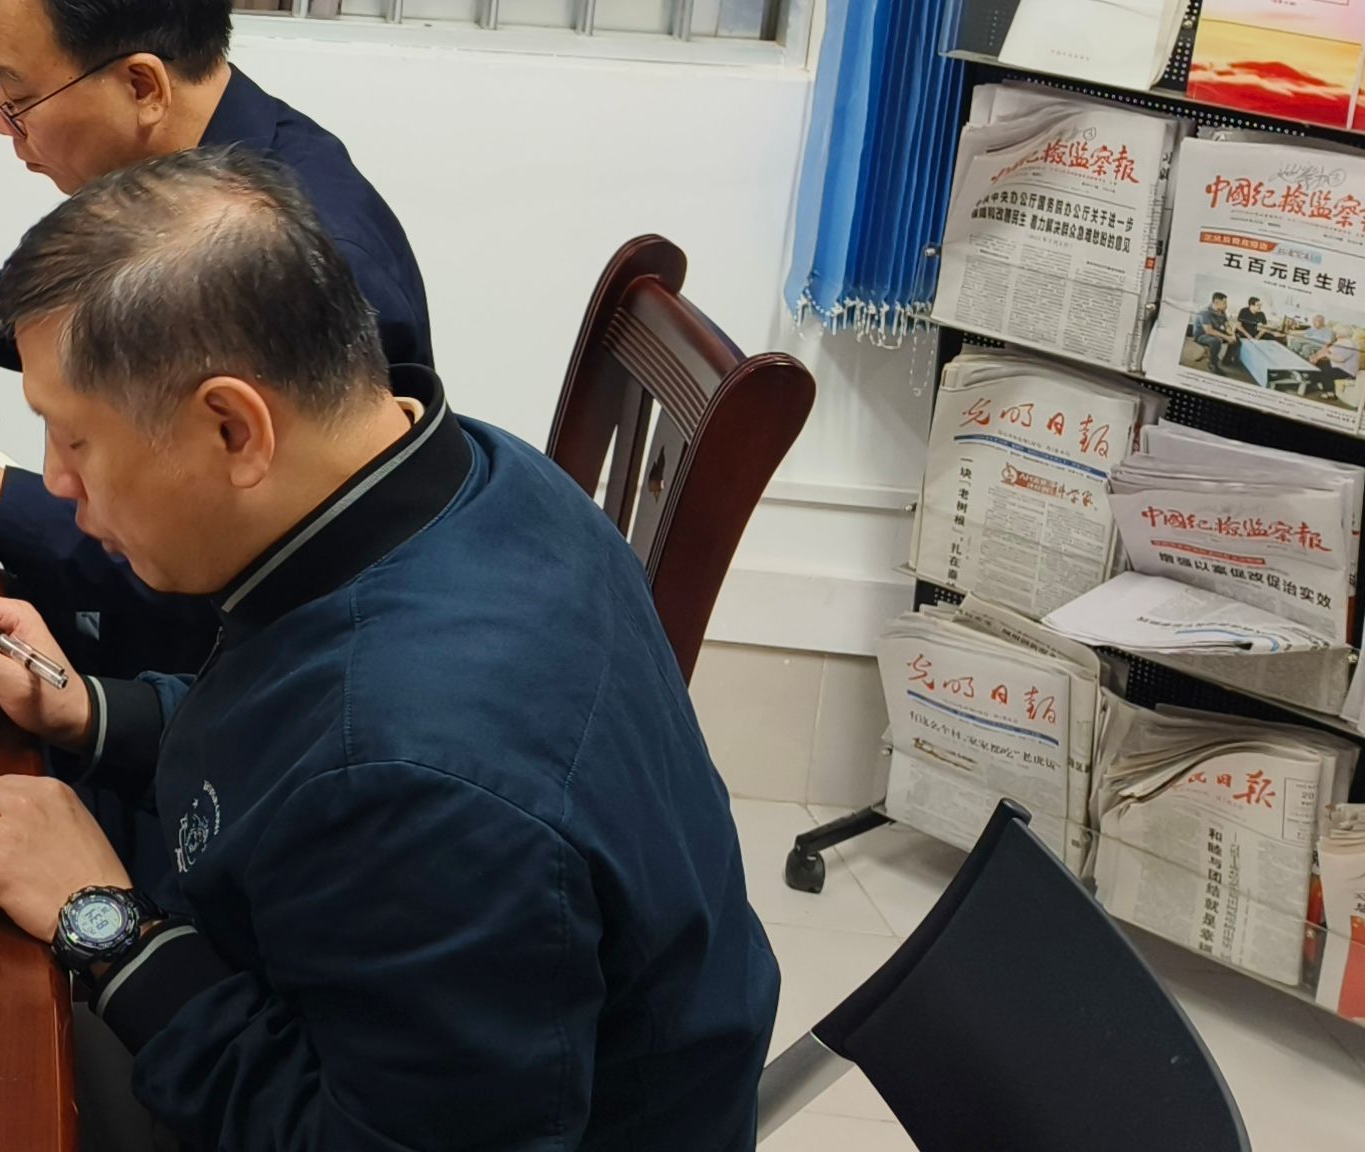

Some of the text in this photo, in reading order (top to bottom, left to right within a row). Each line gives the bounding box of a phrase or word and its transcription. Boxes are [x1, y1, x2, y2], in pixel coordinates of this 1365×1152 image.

[1205, 175, 1365, 233] 中國紀檢監察
[1223, 251, 1357, 296] 五百元民生账
